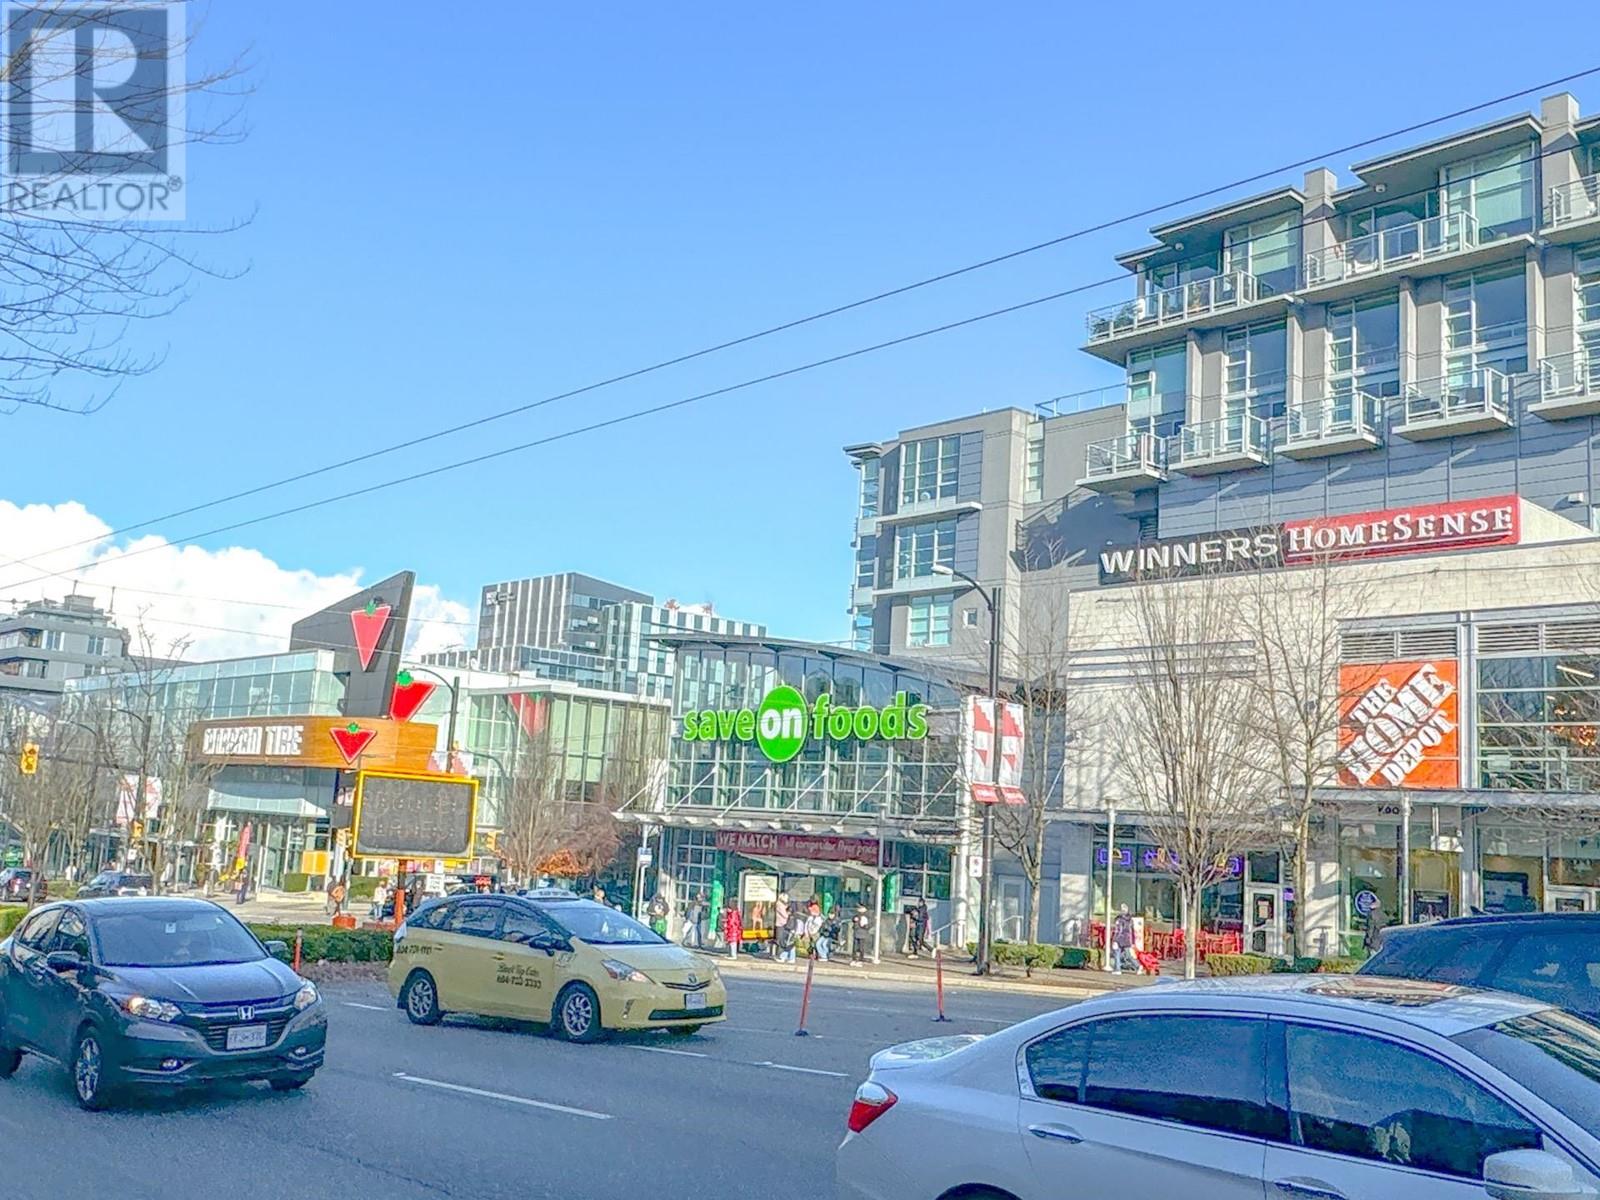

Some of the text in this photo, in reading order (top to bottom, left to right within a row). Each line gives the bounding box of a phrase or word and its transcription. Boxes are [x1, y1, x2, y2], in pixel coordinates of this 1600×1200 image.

[1100, 533, 1278, 575] WINNERS
[683, 691, 929, 741] save on foods
[1338, 663, 1457, 786] HOME
[1348, 678, 1398, 725] THE
[1380, 709, 1457, 786] DEPOT
[718, 832, 735, 847] WE
[738, 833, 778, 850] MATCH
